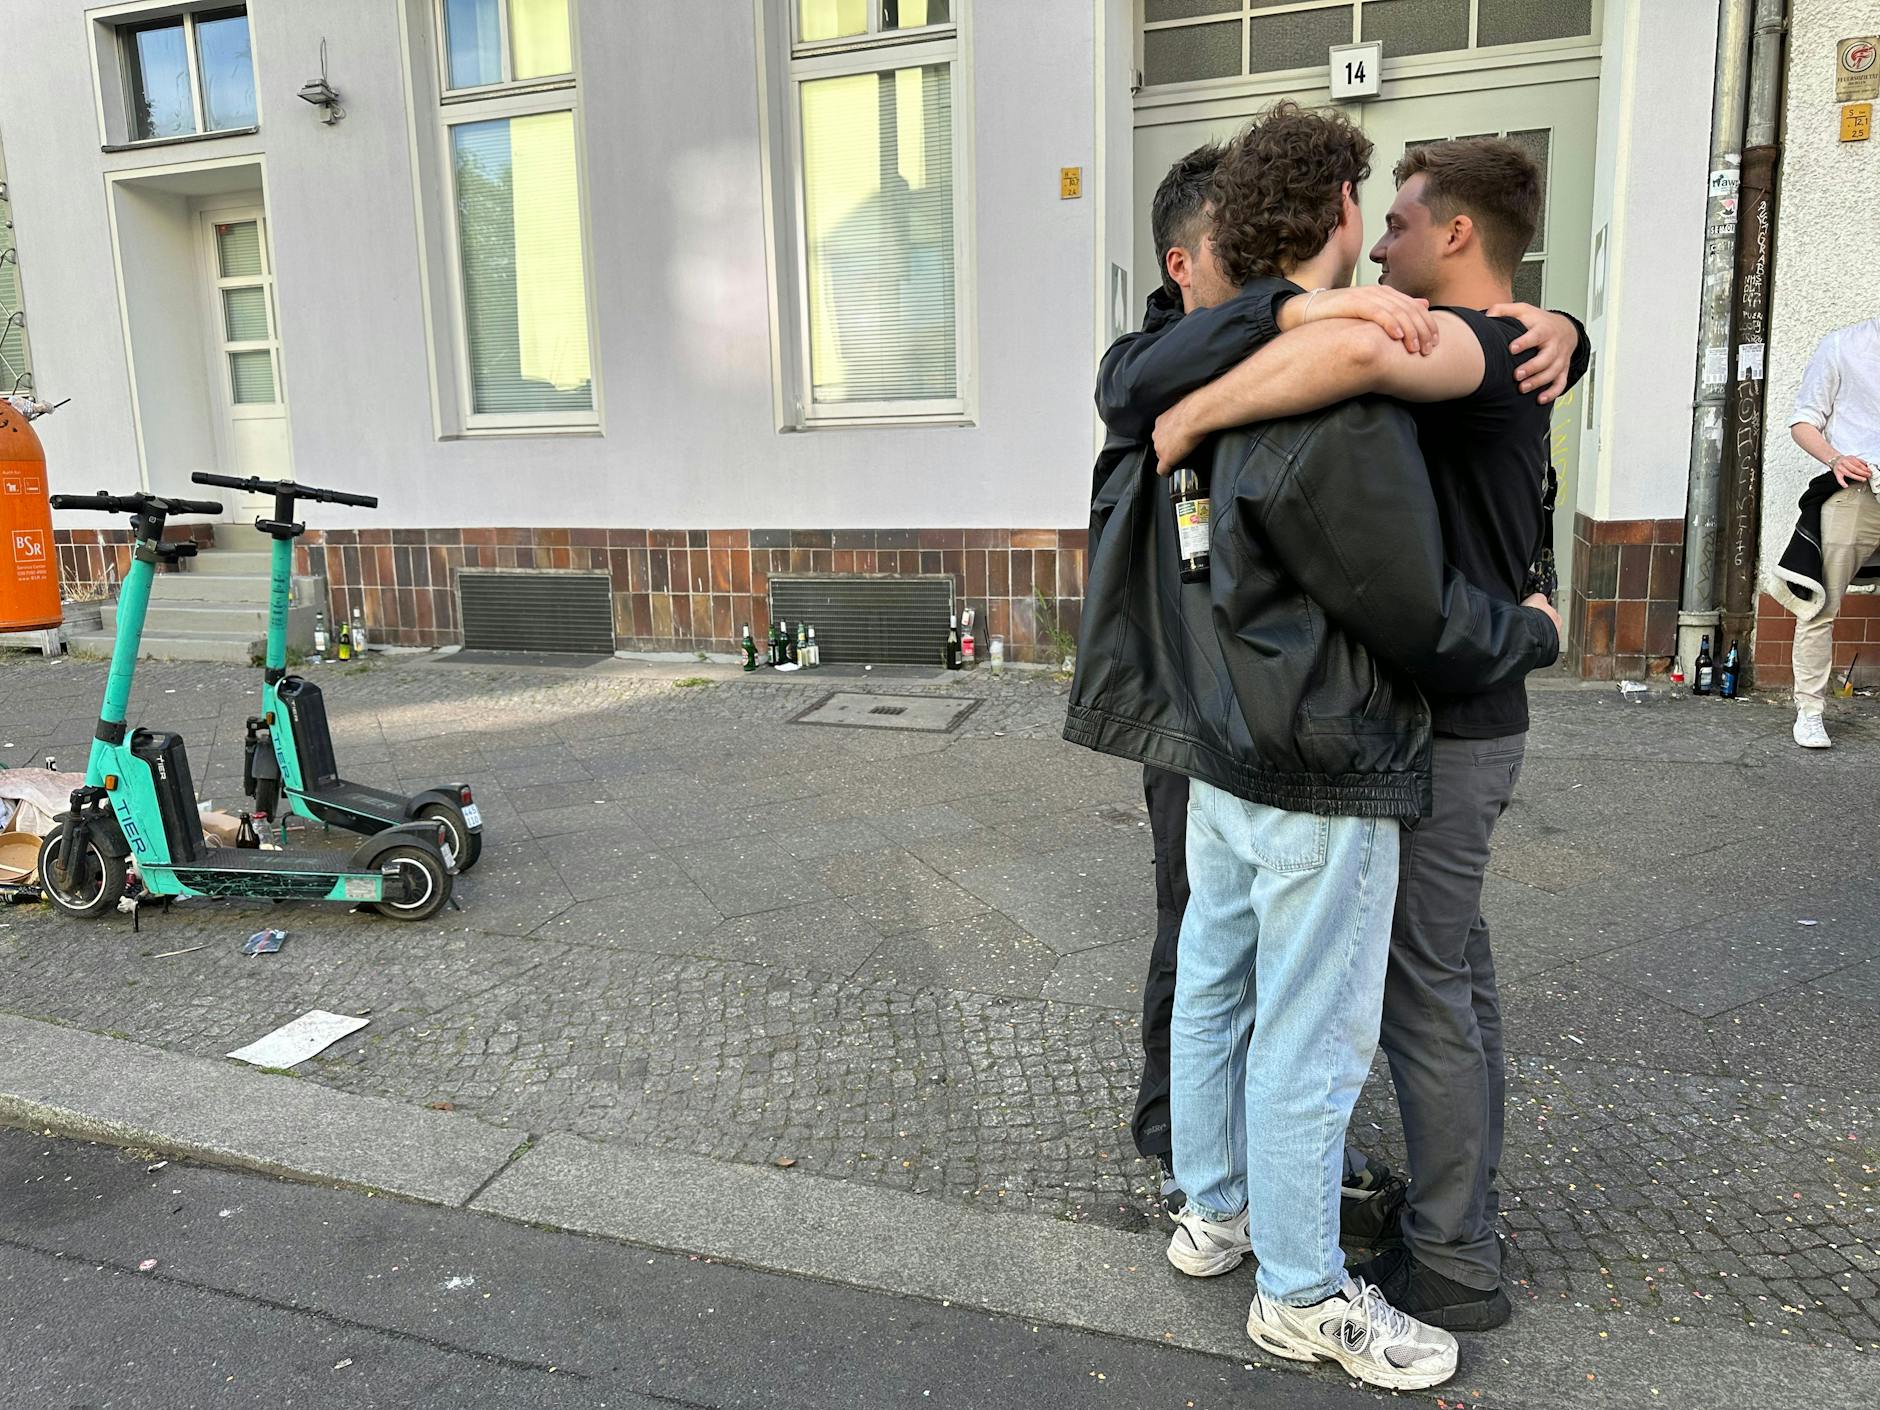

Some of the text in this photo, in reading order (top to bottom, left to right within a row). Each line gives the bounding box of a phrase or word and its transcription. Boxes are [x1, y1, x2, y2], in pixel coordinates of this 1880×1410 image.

[1345, 61, 1366, 85] 14
[16, 536, 42, 556] BSR
[156, 754, 167, 780] TIER
[274, 732, 290, 778] TIER
[117, 799, 147, 855] TIER
